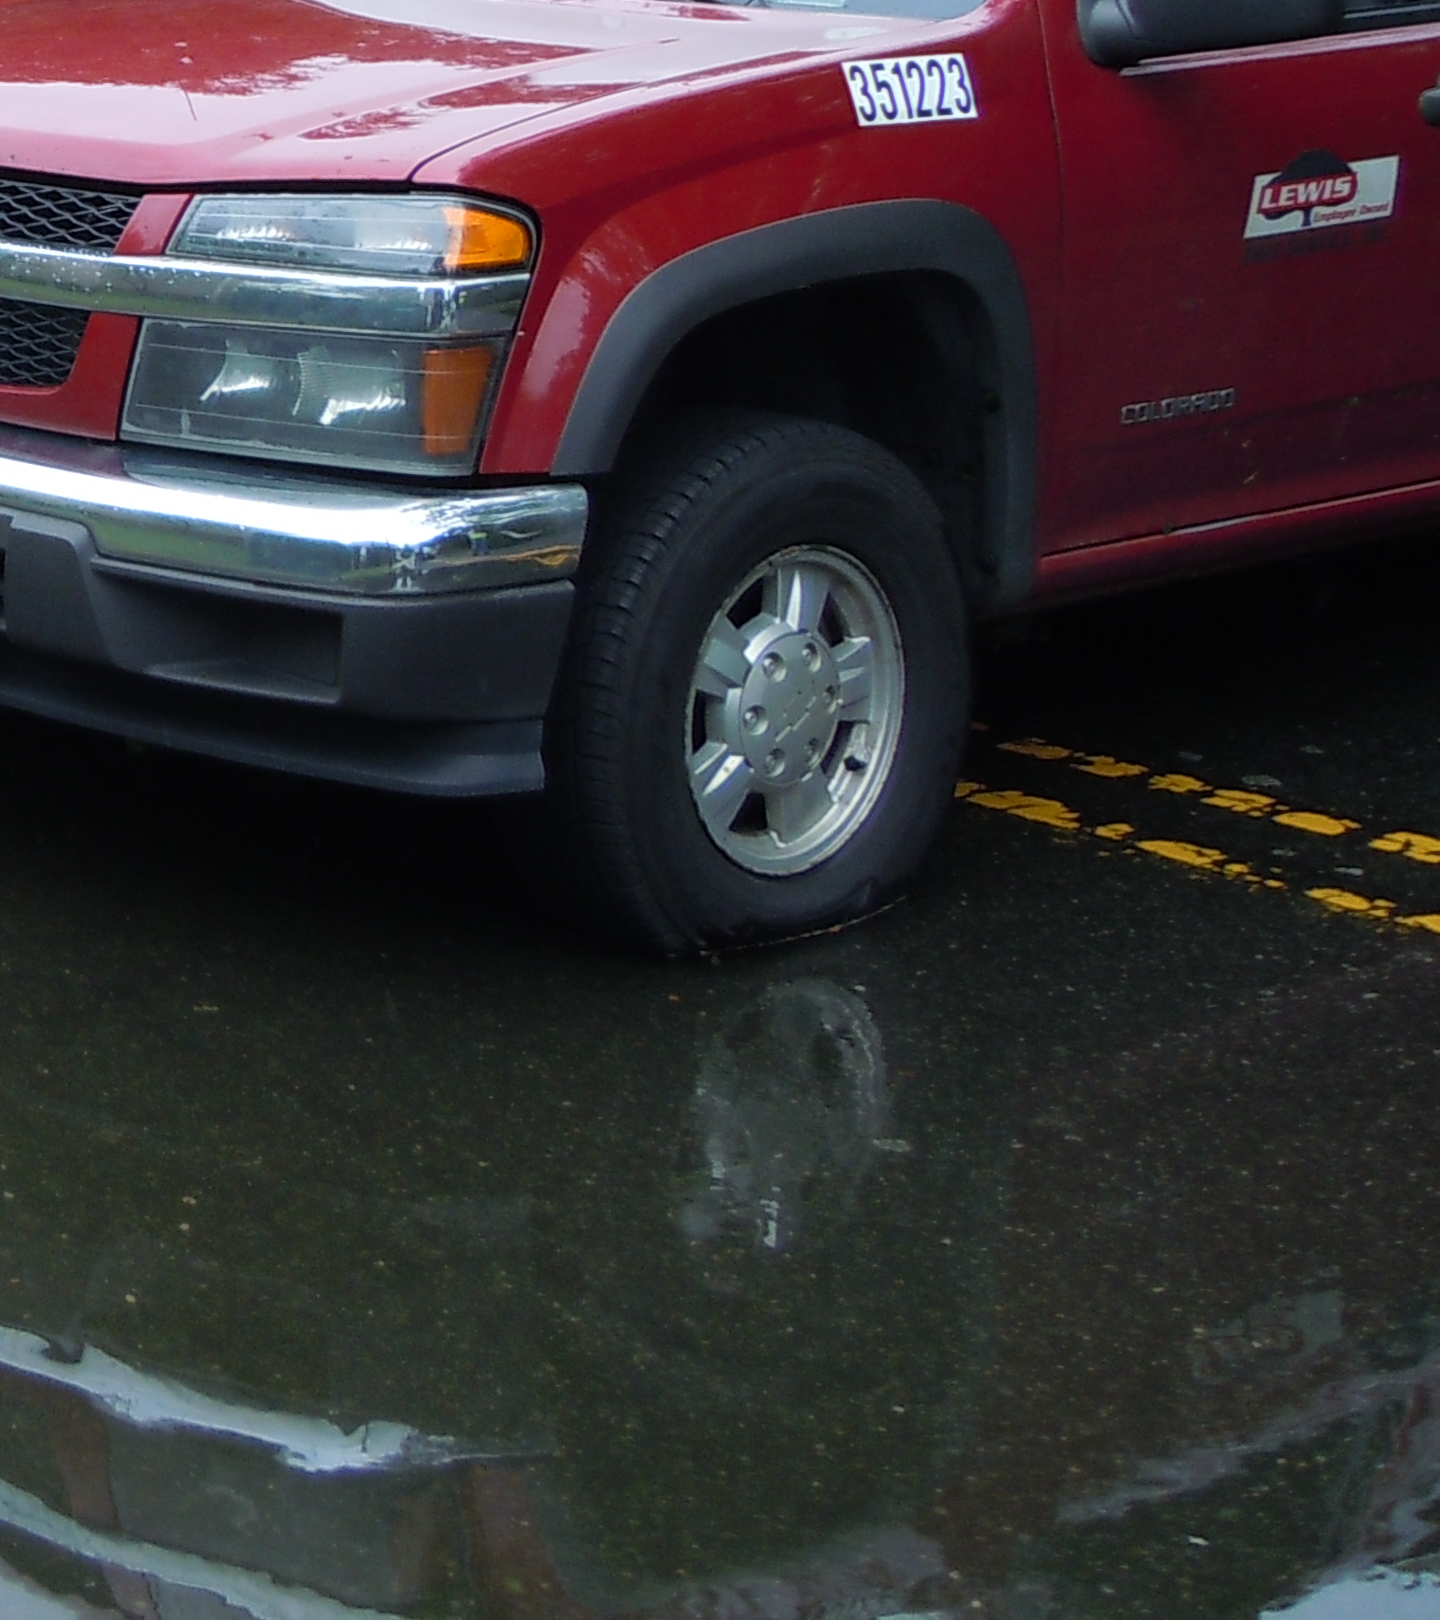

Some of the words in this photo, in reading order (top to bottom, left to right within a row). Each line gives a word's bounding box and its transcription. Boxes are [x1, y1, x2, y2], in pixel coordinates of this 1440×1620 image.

[848, 57, 972, 122] 351223
[1261, 176, 1353, 210] LEWIS
[1121, 387, 1235, 424] COLORADO
